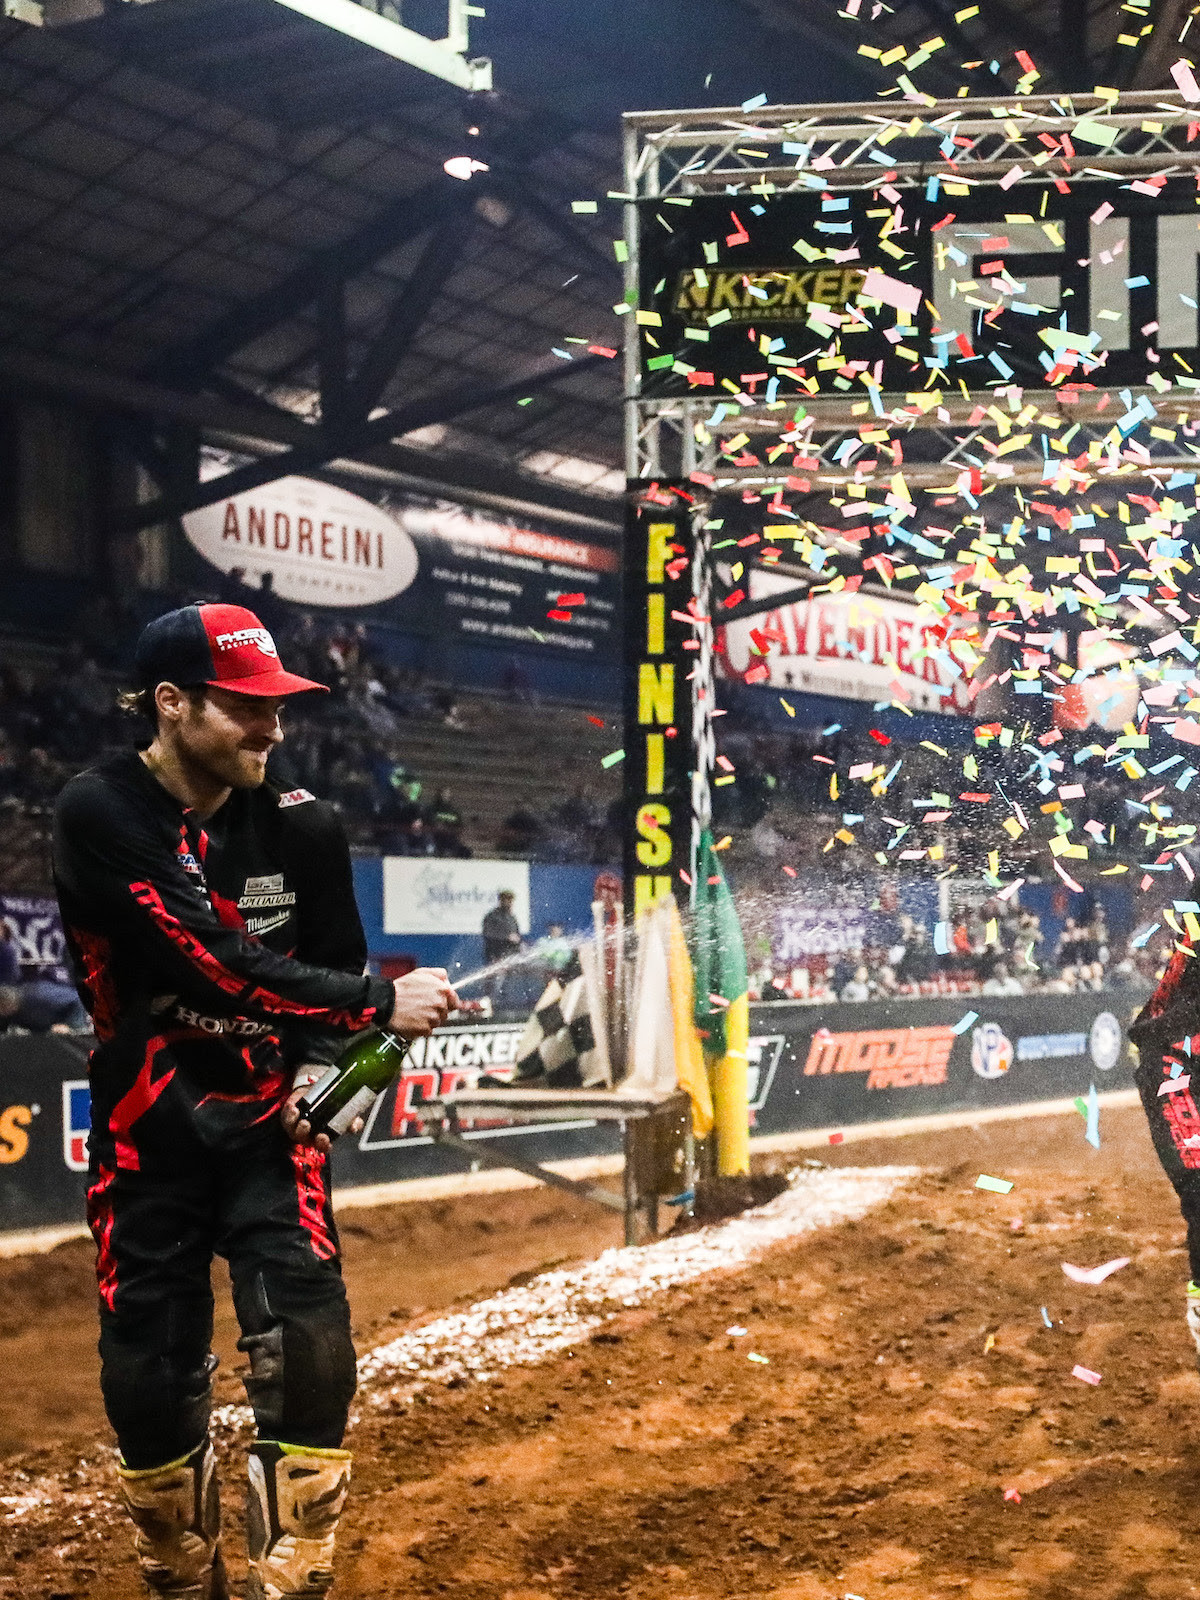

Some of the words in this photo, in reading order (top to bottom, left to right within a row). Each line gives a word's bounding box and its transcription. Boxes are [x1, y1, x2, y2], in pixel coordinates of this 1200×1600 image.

[223, 502, 384, 569] ANDREINI
[634, 523, 676, 932] FINISH
[238, 892, 296, 908] SPECIALIZED
[245, 910, 290, 933] Milwaukee
[175, 1005, 274, 1035] HONDA
[803, 1024, 955, 1076] MOOSE
